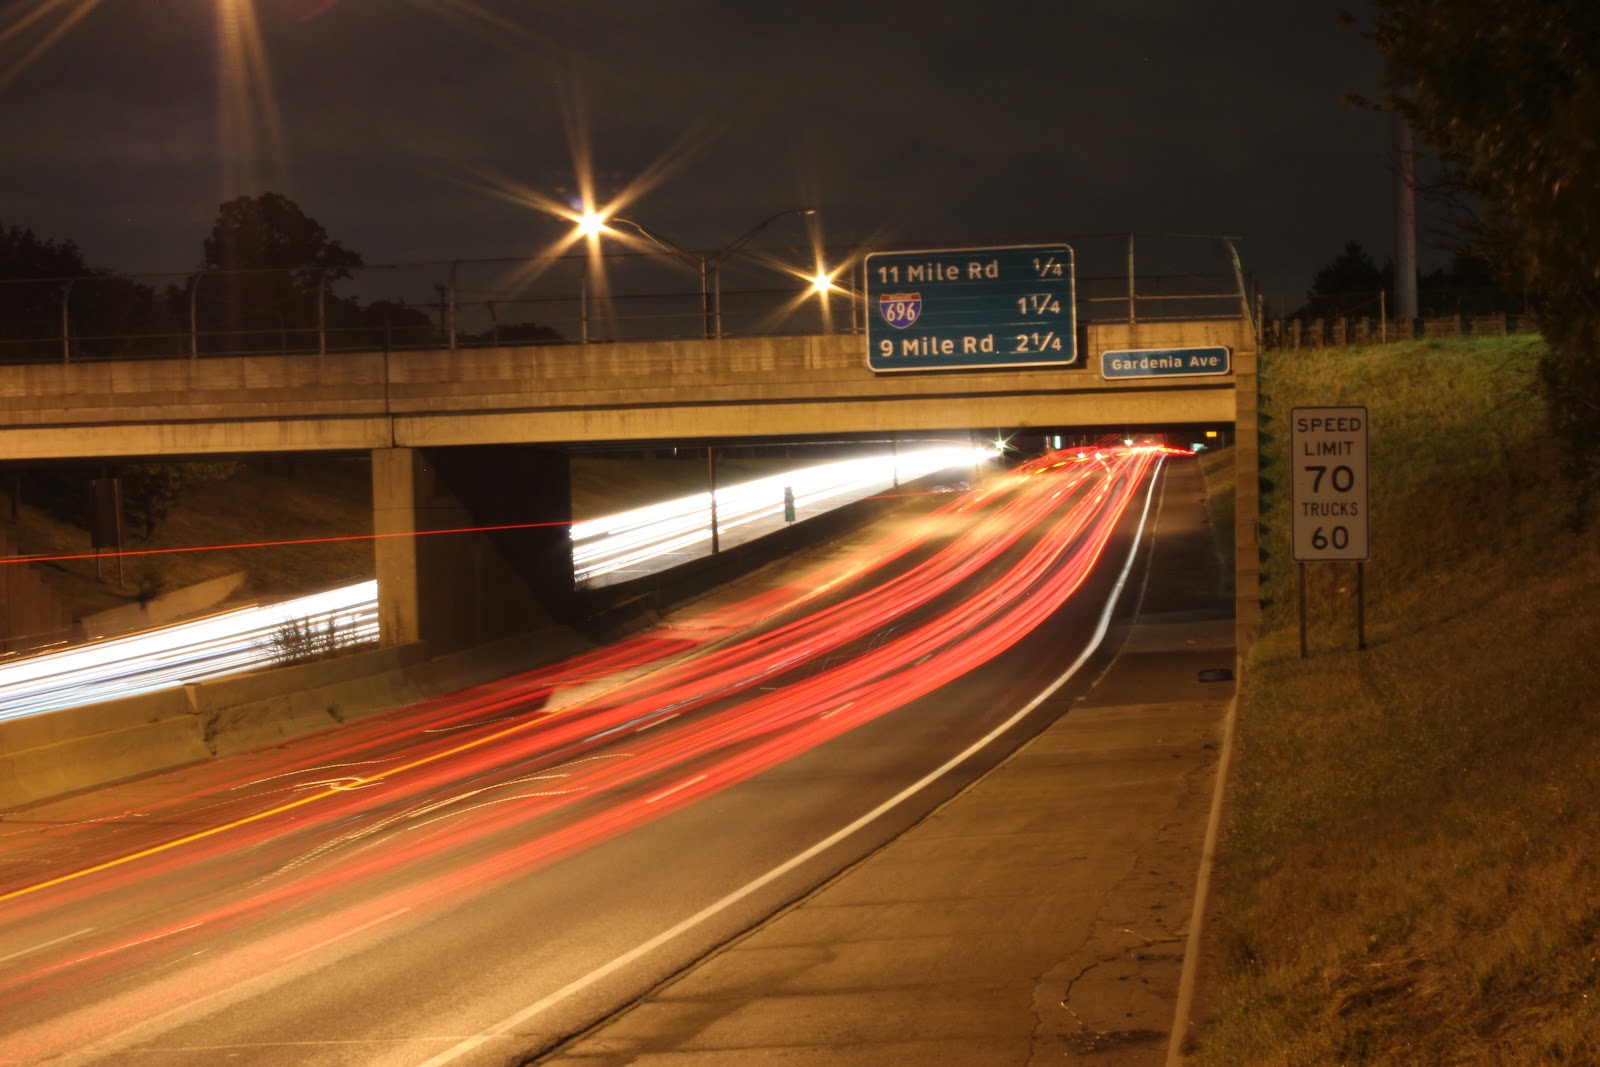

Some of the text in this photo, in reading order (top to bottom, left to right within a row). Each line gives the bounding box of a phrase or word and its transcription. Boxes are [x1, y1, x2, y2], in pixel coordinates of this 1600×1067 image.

[878, 259, 999, 284] 11 Mile Rd
[886, 302, 916, 323] 696
[879, 333, 994, 357] 9 Mile Rd
[1111, 356, 1218, 371] Gardenia Ave
[1298, 417, 1362, 433] SPEED
[1304, 441, 1354, 457] LIMIT
[1304, 465, 1355, 493] 70
[1302, 502, 1359, 517] TRUCKS
[1312, 525, 1349, 550] 60
